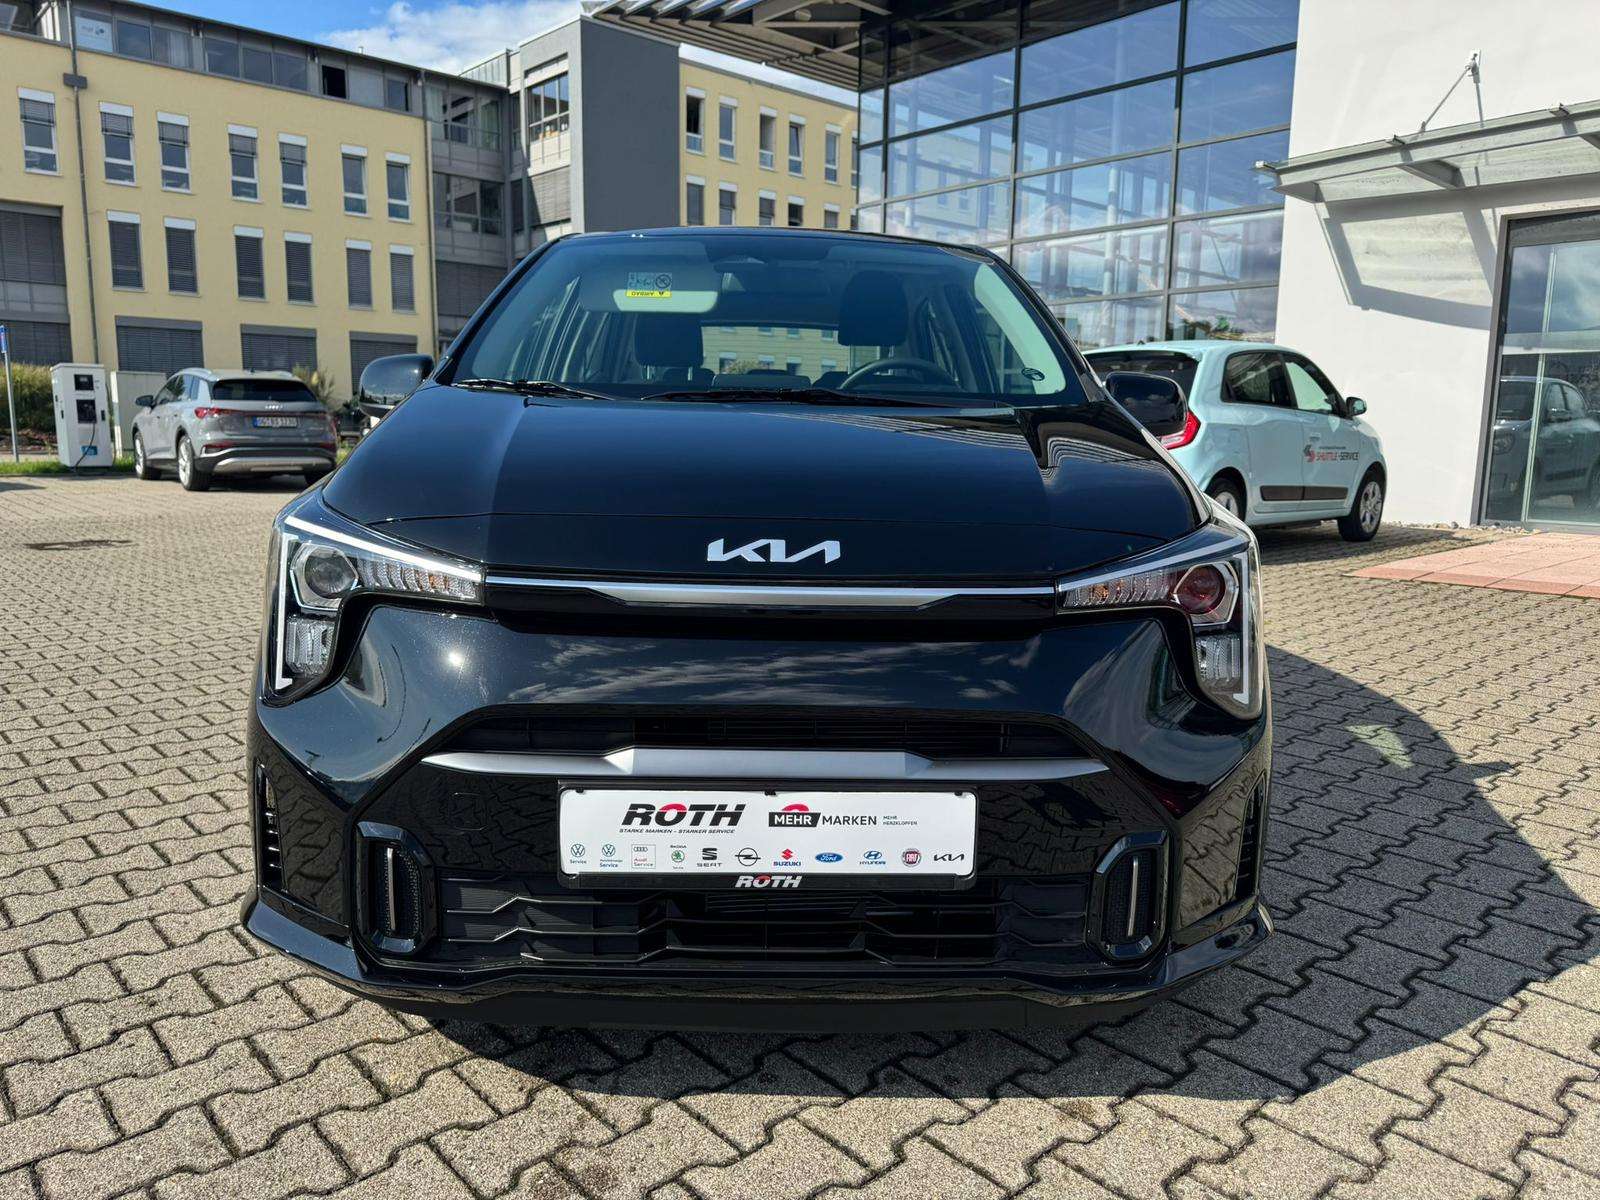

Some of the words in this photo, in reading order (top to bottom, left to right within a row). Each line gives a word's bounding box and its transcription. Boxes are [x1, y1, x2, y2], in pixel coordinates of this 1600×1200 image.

[707, 538, 841, 564] KIA
[621, 803, 746, 826] ROTH
[774, 814, 812, 825] MEHR
[822, 815, 877, 826] MARKEN
[734, 875, 803, 888] ROTH
